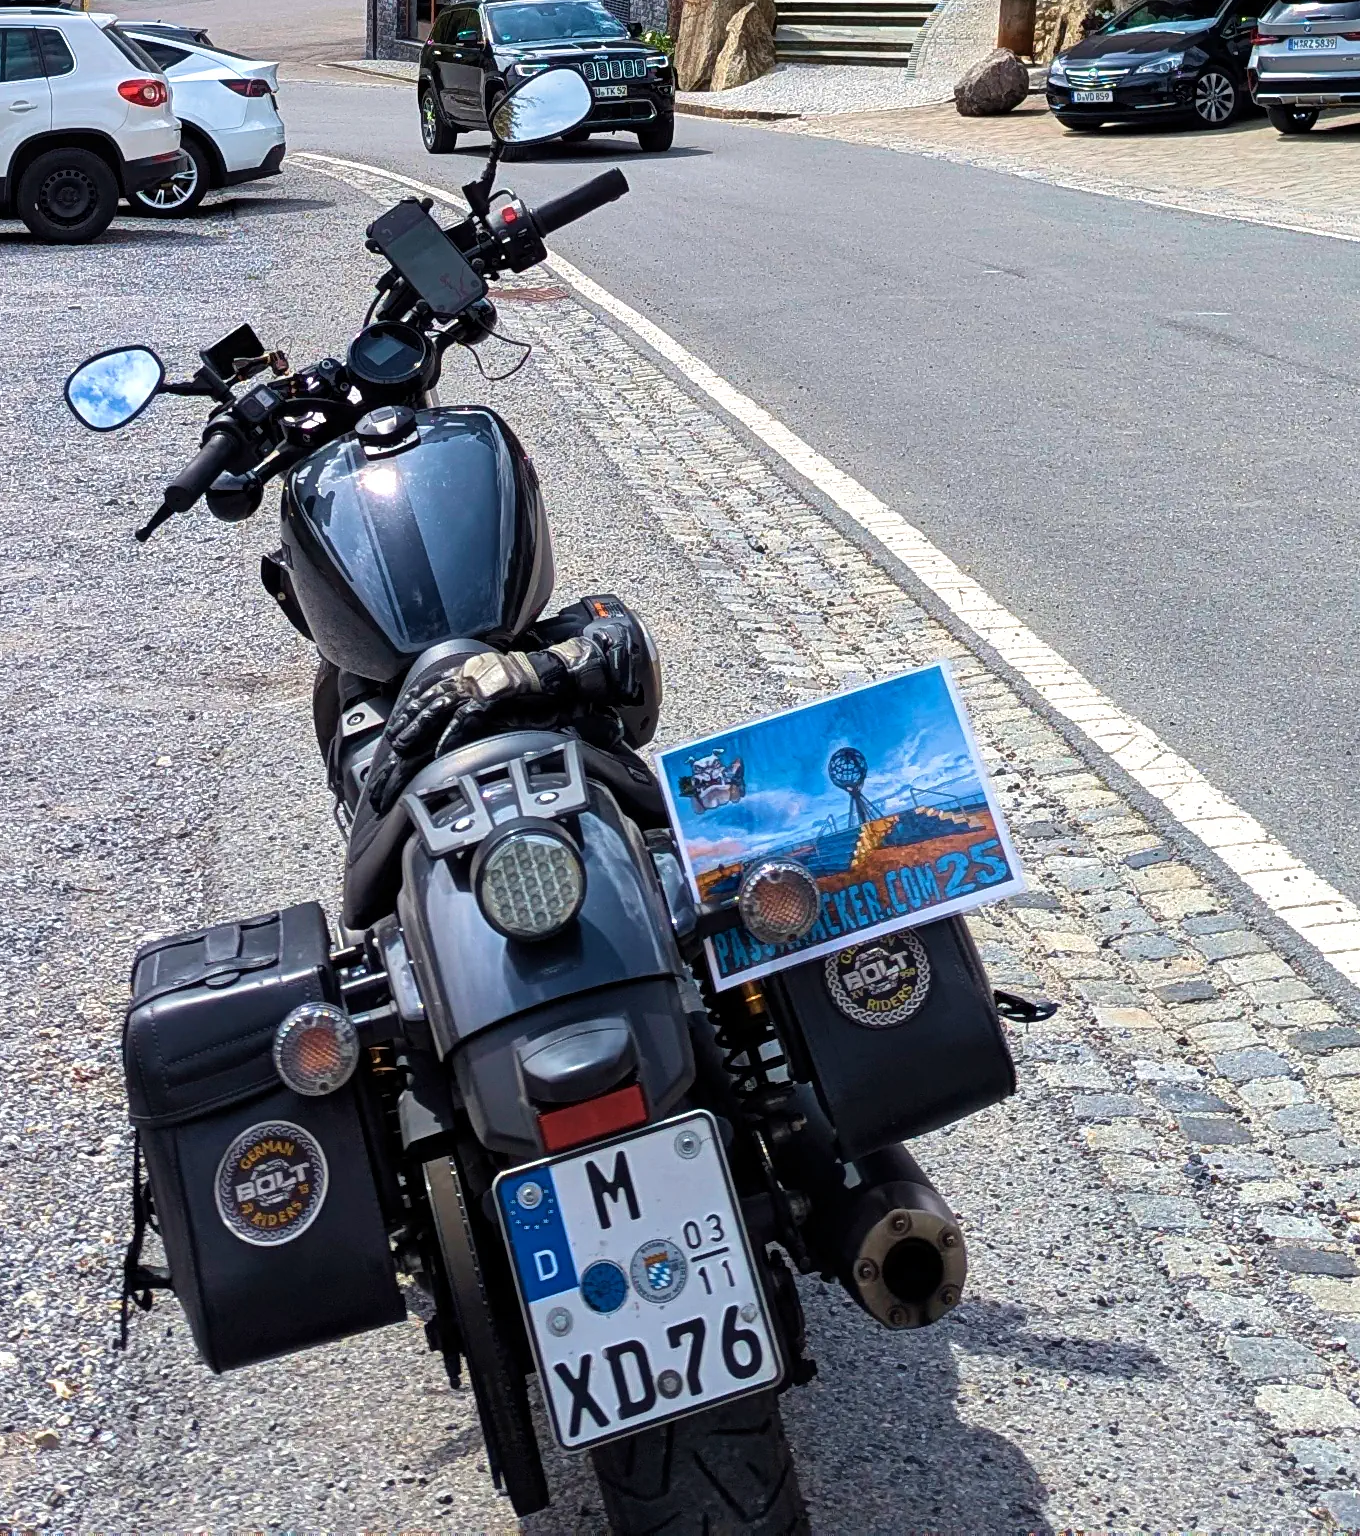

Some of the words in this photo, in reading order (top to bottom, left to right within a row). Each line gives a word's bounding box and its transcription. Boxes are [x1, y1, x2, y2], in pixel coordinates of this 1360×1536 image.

[935, 839, 1008, 898] 25
[842, 950, 909, 991] BOLT
[866, 984, 913, 1012] RIDERS
[240, 1140, 295, 1170] GERMAN
[235, 1162, 310, 1203] BOLT
[585, 1150, 641, 1230] M
[251, 1201, 303, 1226] RIDERS
[682, 1213, 725, 1250] 03
[533, 1249, 559, 1282] D
[697, 1260, 736, 1295] 11
[553, 1339, 657, 1438] XD
[666, 1304, 763, 1397] 76
